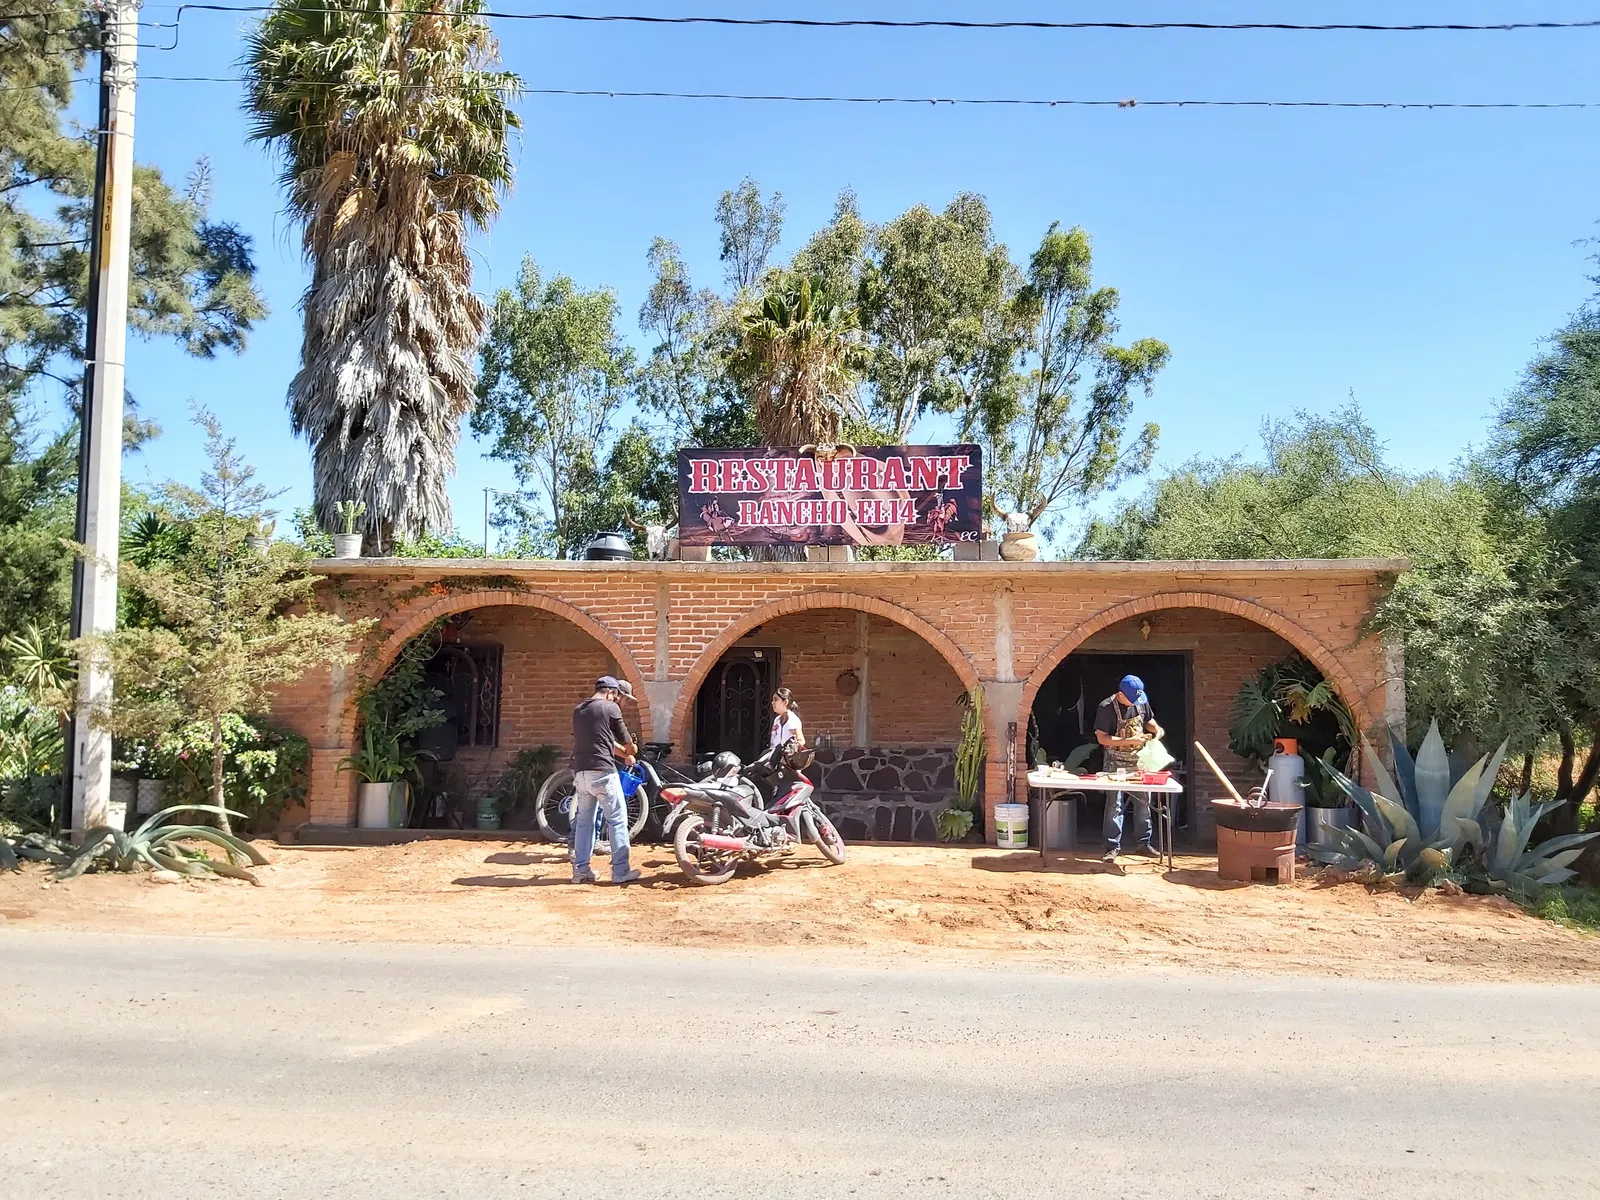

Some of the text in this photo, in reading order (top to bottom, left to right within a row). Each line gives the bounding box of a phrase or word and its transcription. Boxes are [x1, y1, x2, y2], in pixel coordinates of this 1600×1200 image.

[687, 456, 973, 493] RESTAURANT
[737, 499, 848, 526] RANCHO
[960, 531, 978, 542] EC
